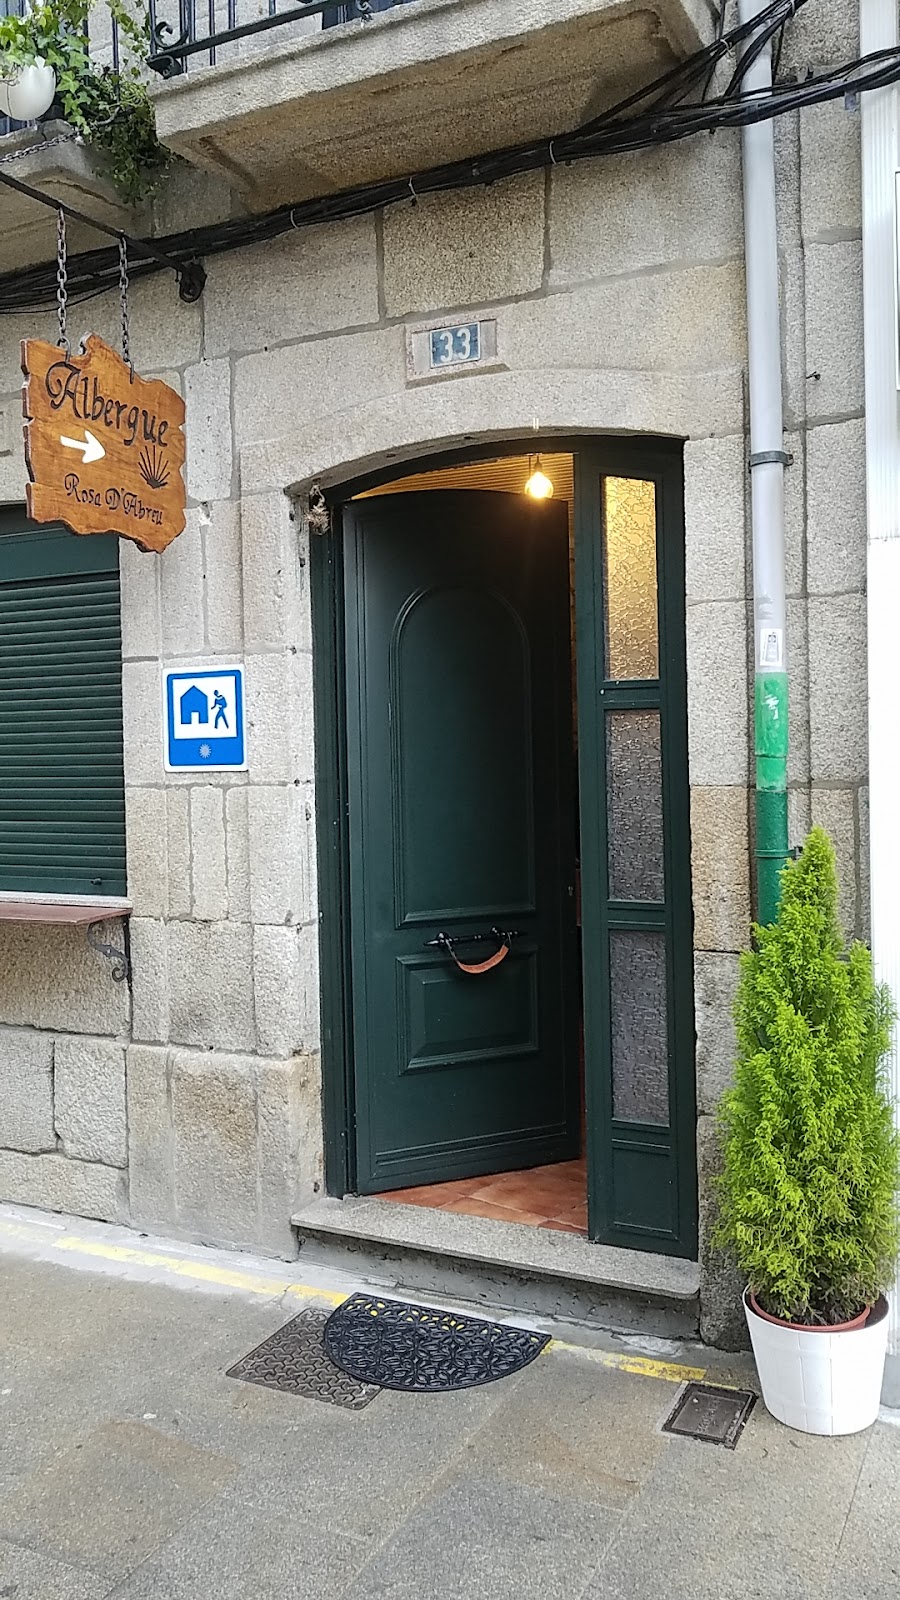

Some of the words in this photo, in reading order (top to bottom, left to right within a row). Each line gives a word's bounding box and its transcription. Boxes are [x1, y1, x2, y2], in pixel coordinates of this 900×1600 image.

[440, 327, 471, 362] 33
[45, 361, 168, 447] Albergue
[64, 472, 102, 507] Rosa
